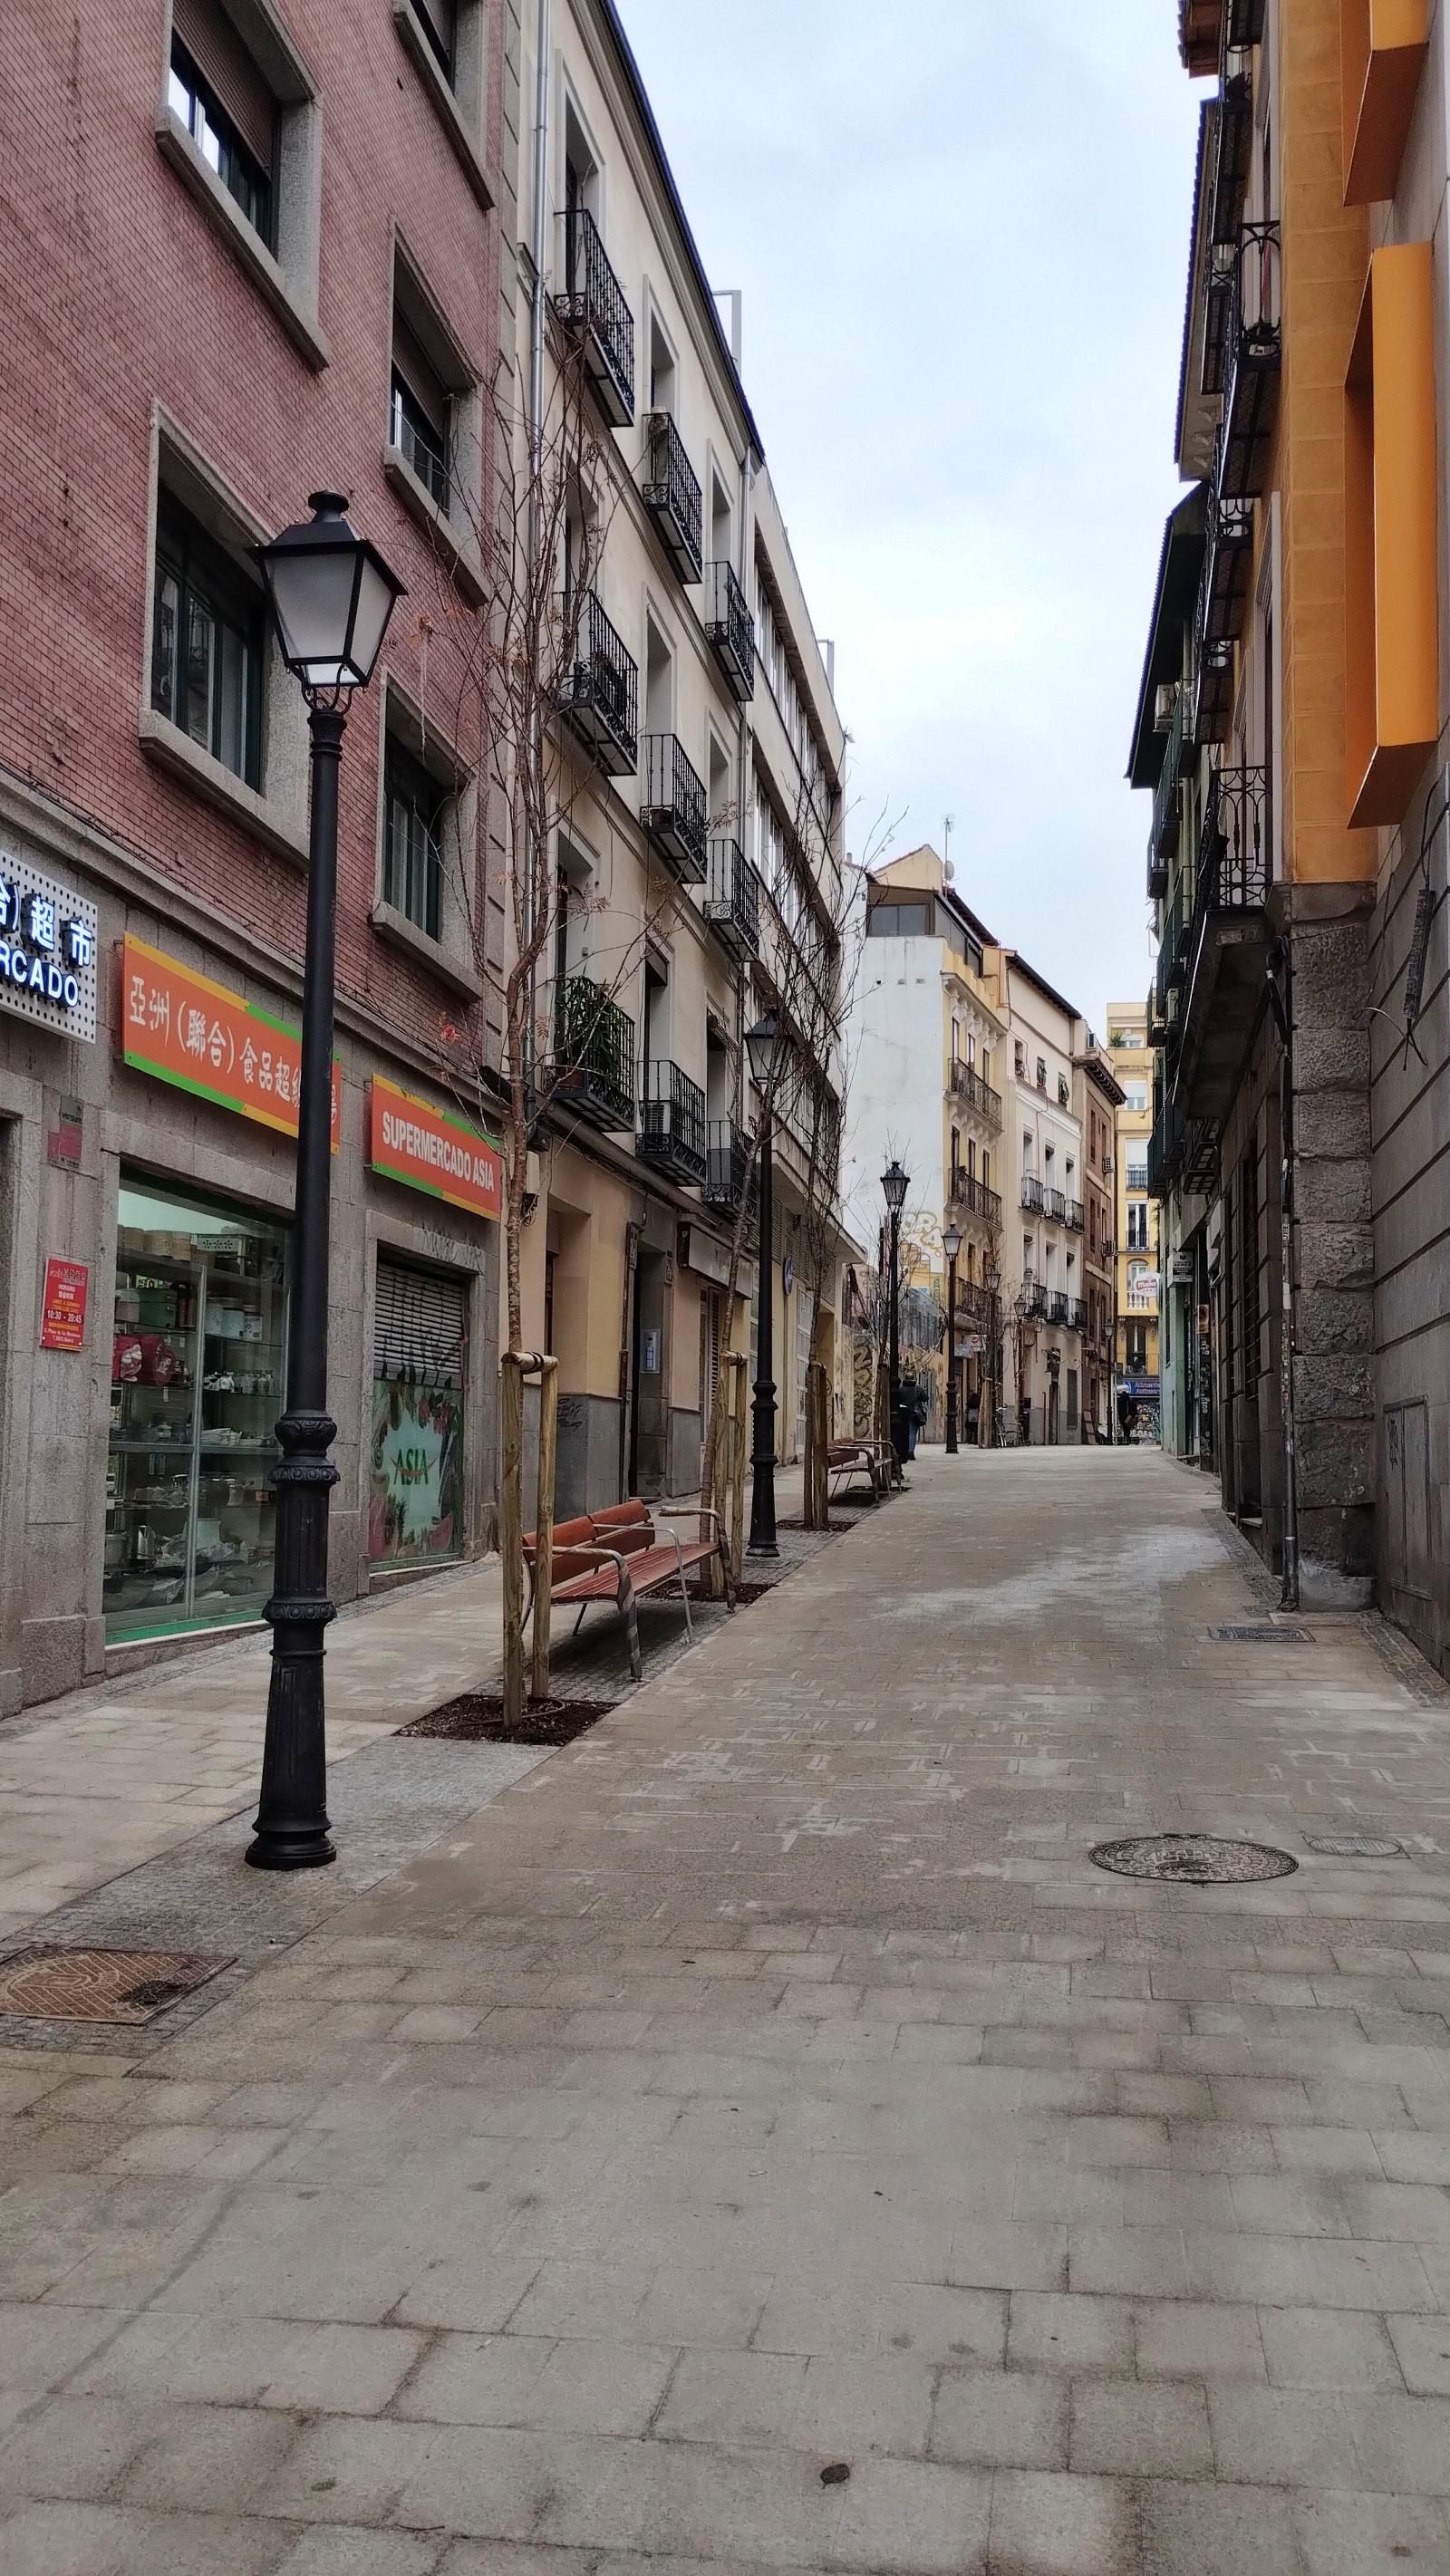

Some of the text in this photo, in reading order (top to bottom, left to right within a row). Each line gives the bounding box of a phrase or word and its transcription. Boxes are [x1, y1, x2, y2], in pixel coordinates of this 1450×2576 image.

[382, 1111, 495, 1192] SUPERMERCADO ASIA
[47, 1309, 62, 1320] 10:30
[393, 1448, 429, 1486] ASIA
